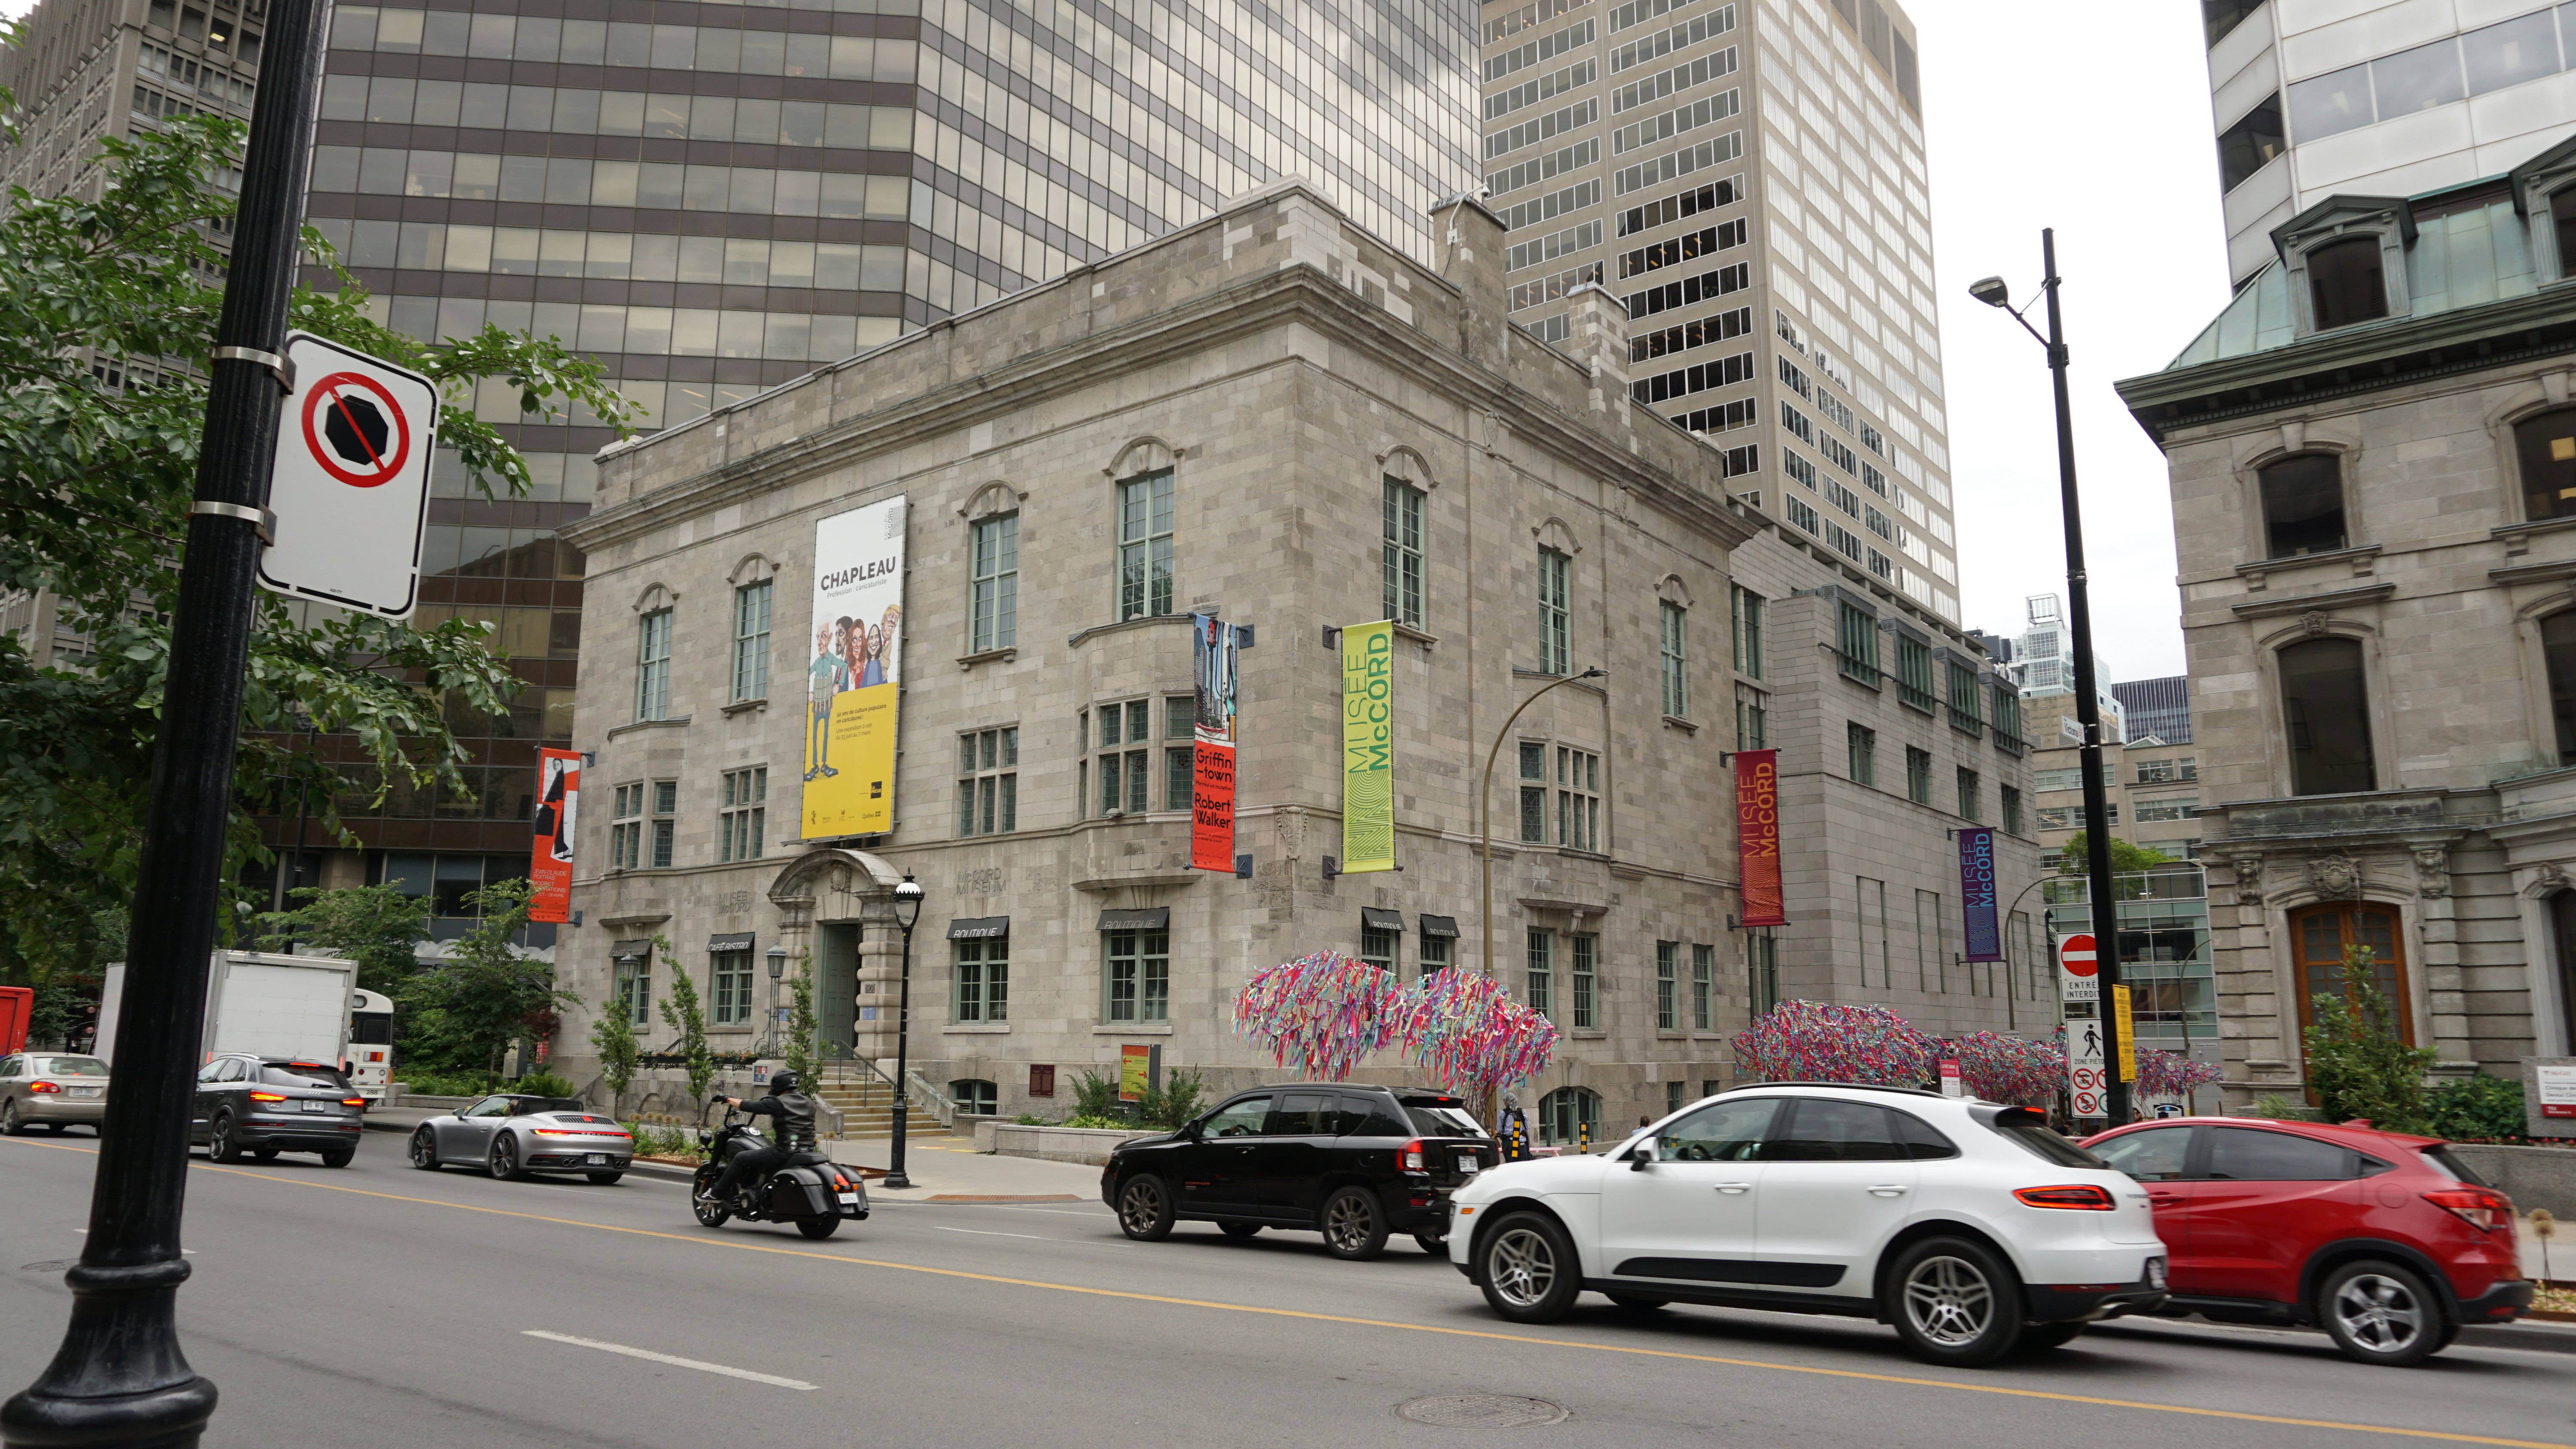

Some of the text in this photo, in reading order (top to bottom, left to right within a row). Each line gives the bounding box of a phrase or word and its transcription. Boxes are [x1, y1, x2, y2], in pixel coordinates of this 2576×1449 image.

[821, 556, 896, 591] CHAPLEAU
[827, 588, 852, 599] Profession
[856, 579, 887, 591] caricaturiste
[1367, 633, 1389, 771] McCORD
[1344, 652, 1368, 773] MUSÉE
[2064, 722, 2079, 737] Victoria
[1196, 749, 1232, 769] Griffin
[1195, 792, 1231, 812] Robert
[1756, 763, 1777, 857] McCORD
[1196, 809, 1231, 829] Walker
[1738, 775, 1760, 858] MUSÉE
[957, 867, 1001, 883] McCORD
[1961, 843, 1980, 908] MUSÉE
[1975, 833, 1994, 907] McCORD
[957, 879, 1006, 895] MUSEUM
[719, 890, 747, 903] MUSÉE
[718, 902, 750, 914] McCORD
[953, 928, 997, 938] BOUTIQUE
[1104, 919, 1156, 930] BOUTIQUE
[1373, 921, 1403, 931] BOUTIQUE
[1430, 928, 1457, 937] BOUTIQUE
[707, 942, 749, 951] CAFÉ BISTRO
[2069, 979, 2099, 989] ENTRÉ
